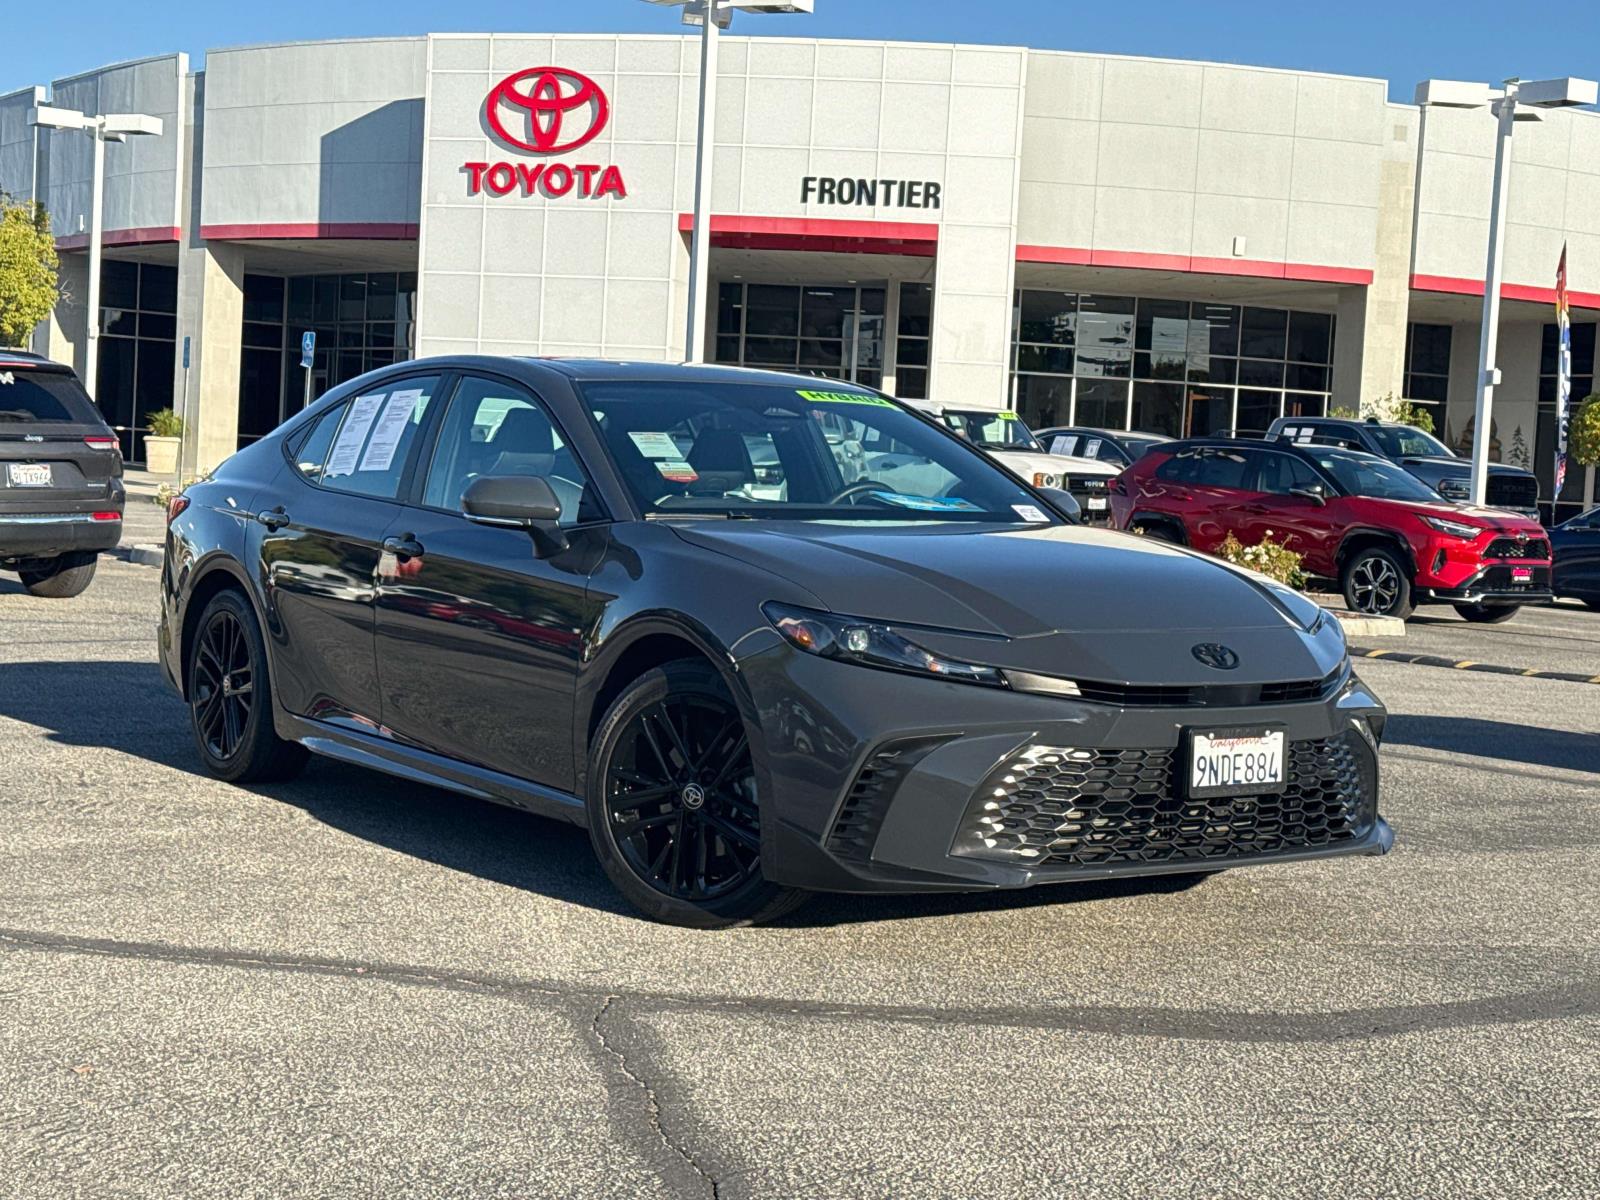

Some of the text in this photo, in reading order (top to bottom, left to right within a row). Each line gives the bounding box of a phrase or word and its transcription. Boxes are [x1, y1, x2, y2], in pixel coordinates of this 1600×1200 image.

[463, 161, 628, 198] TOYOTA
[800, 176, 941, 209] FRONTIER
[806, 391, 888, 405] HYBRID
[24, 434, 44, 442] Jeep
[1195, 751, 1279, 787] 9NDE884
